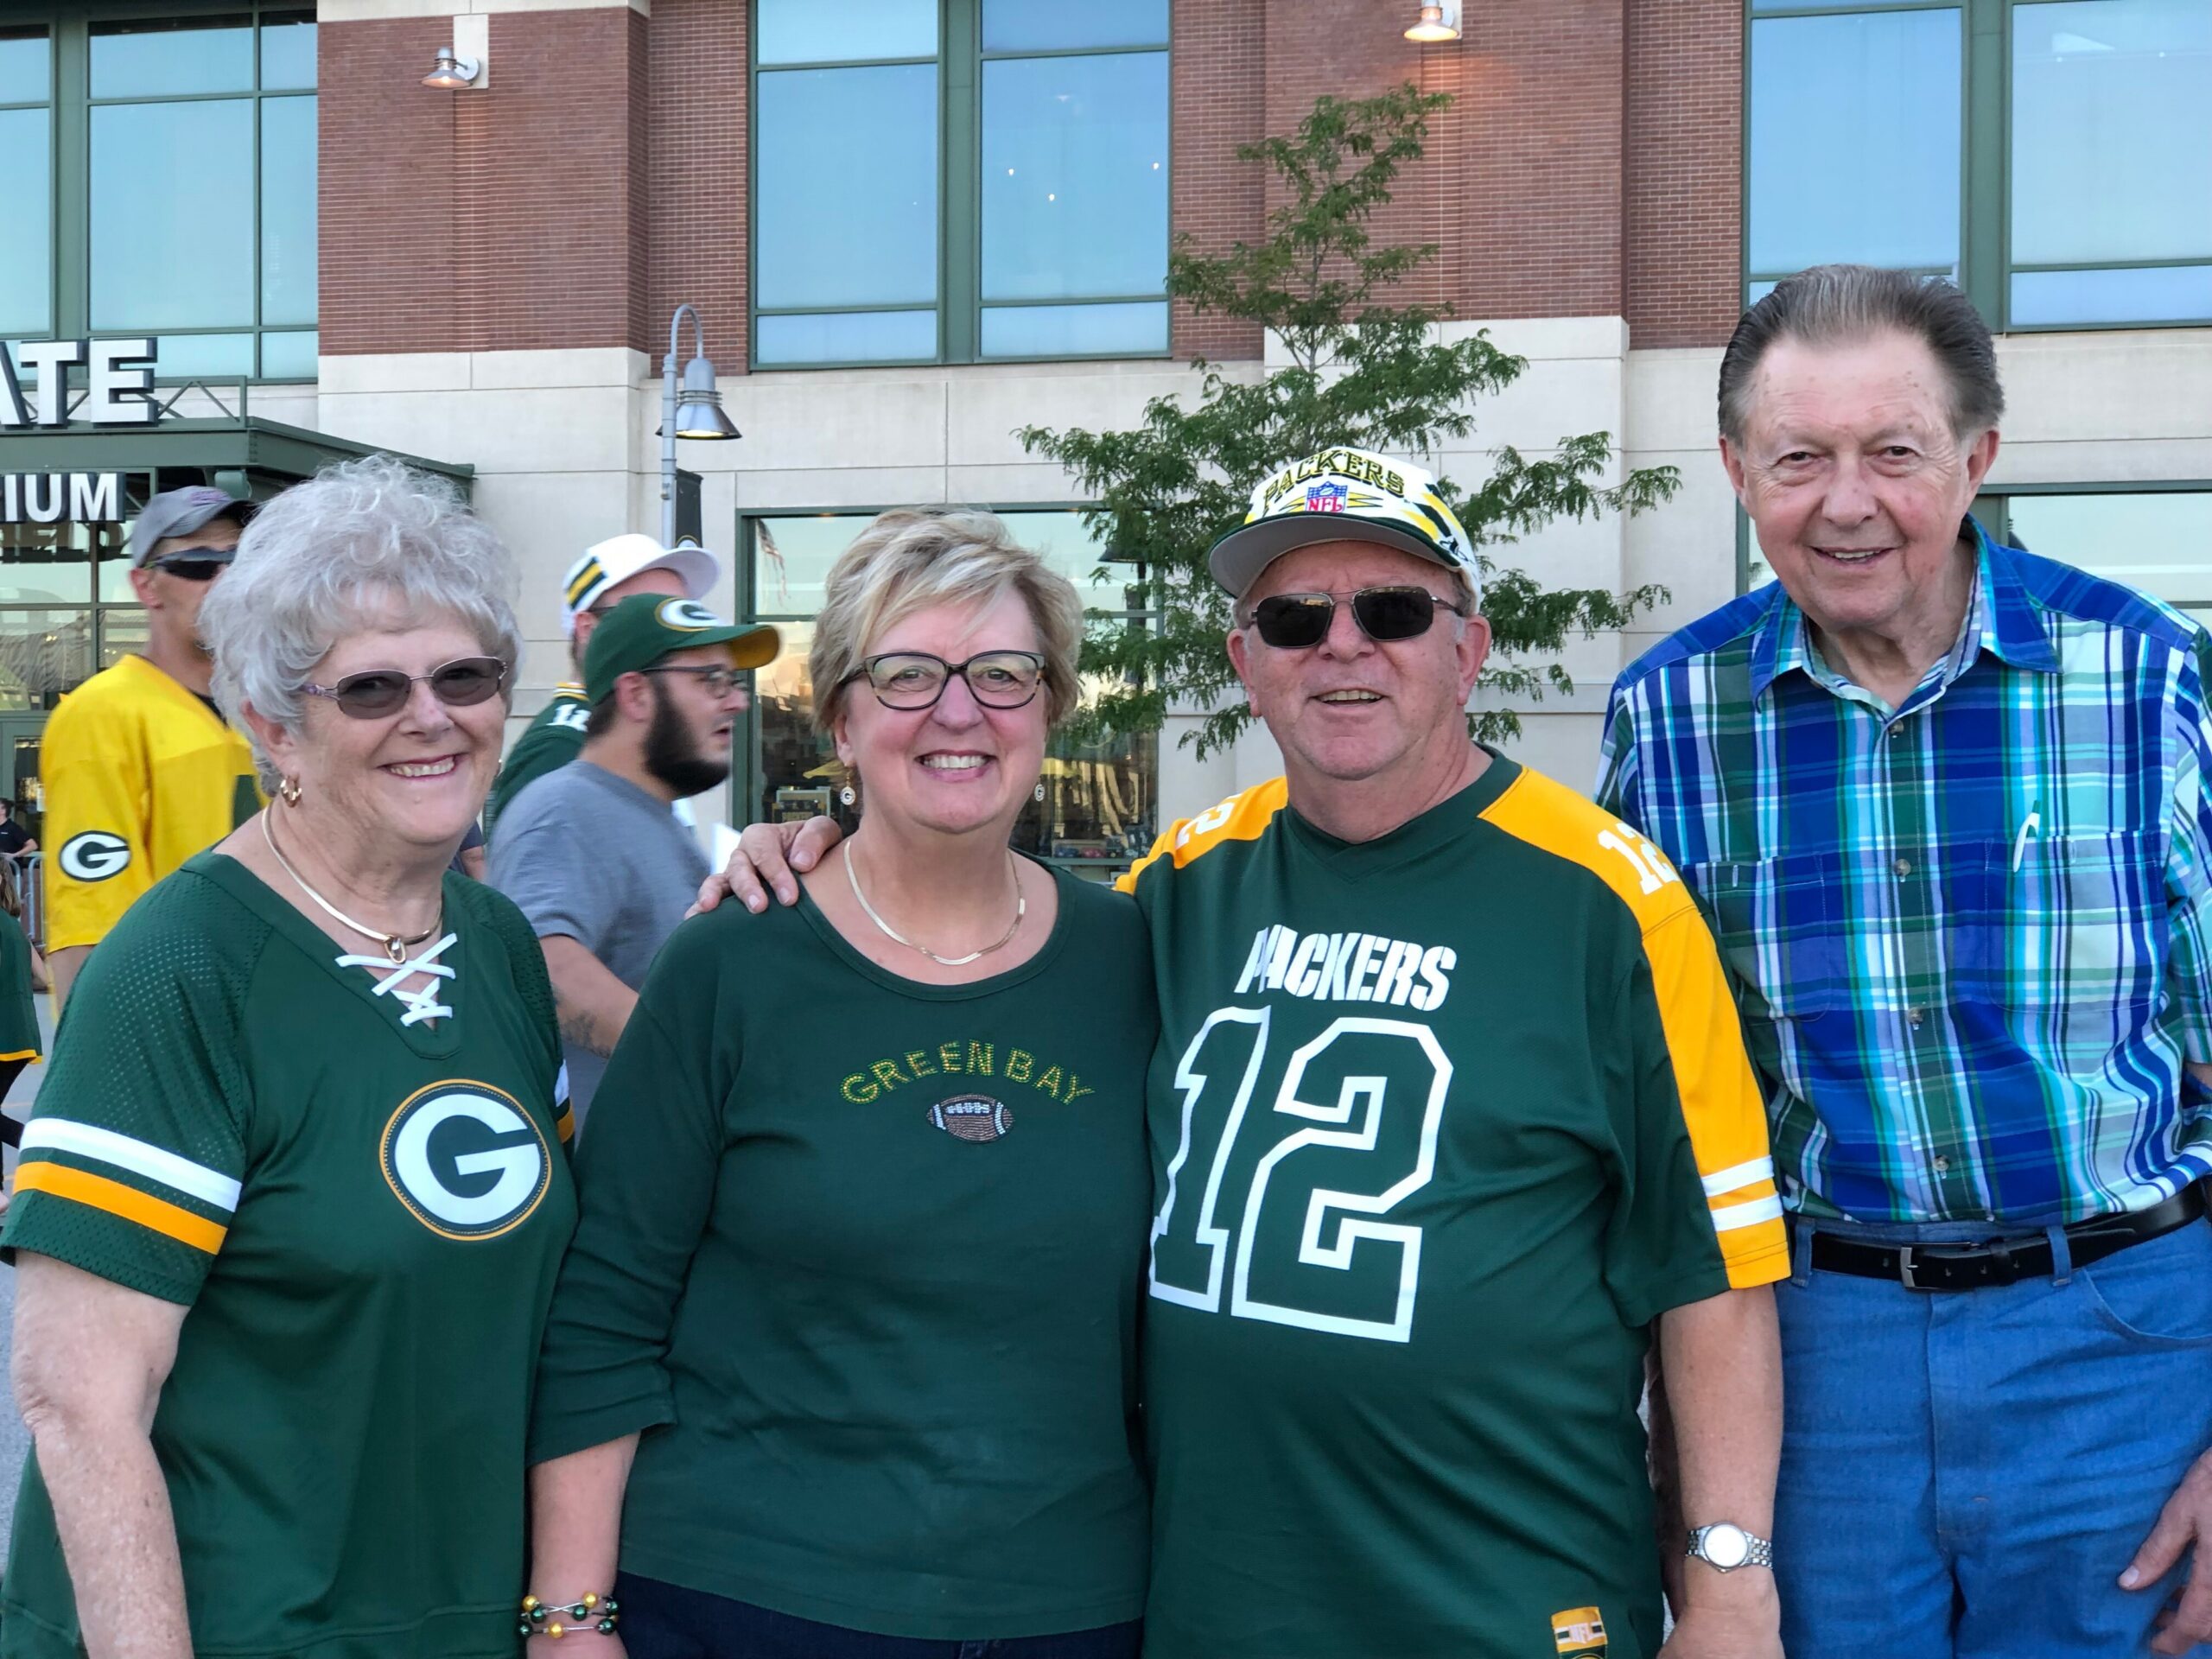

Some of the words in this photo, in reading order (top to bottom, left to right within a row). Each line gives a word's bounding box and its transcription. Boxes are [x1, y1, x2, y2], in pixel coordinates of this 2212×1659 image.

[3, 473, 124, 522] IUM
[1262, 449, 1405, 518] PACKERS
[1306, 496, 1344, 513] NFL
[60, 832, 131, 880] G
[839, 1039, 995, 1105] GREEN
[1004, 1046, 1096, 1106] BAY
[394, 1093, 542, 1226] G
[1149, 1005, 1454, 1344] 12
